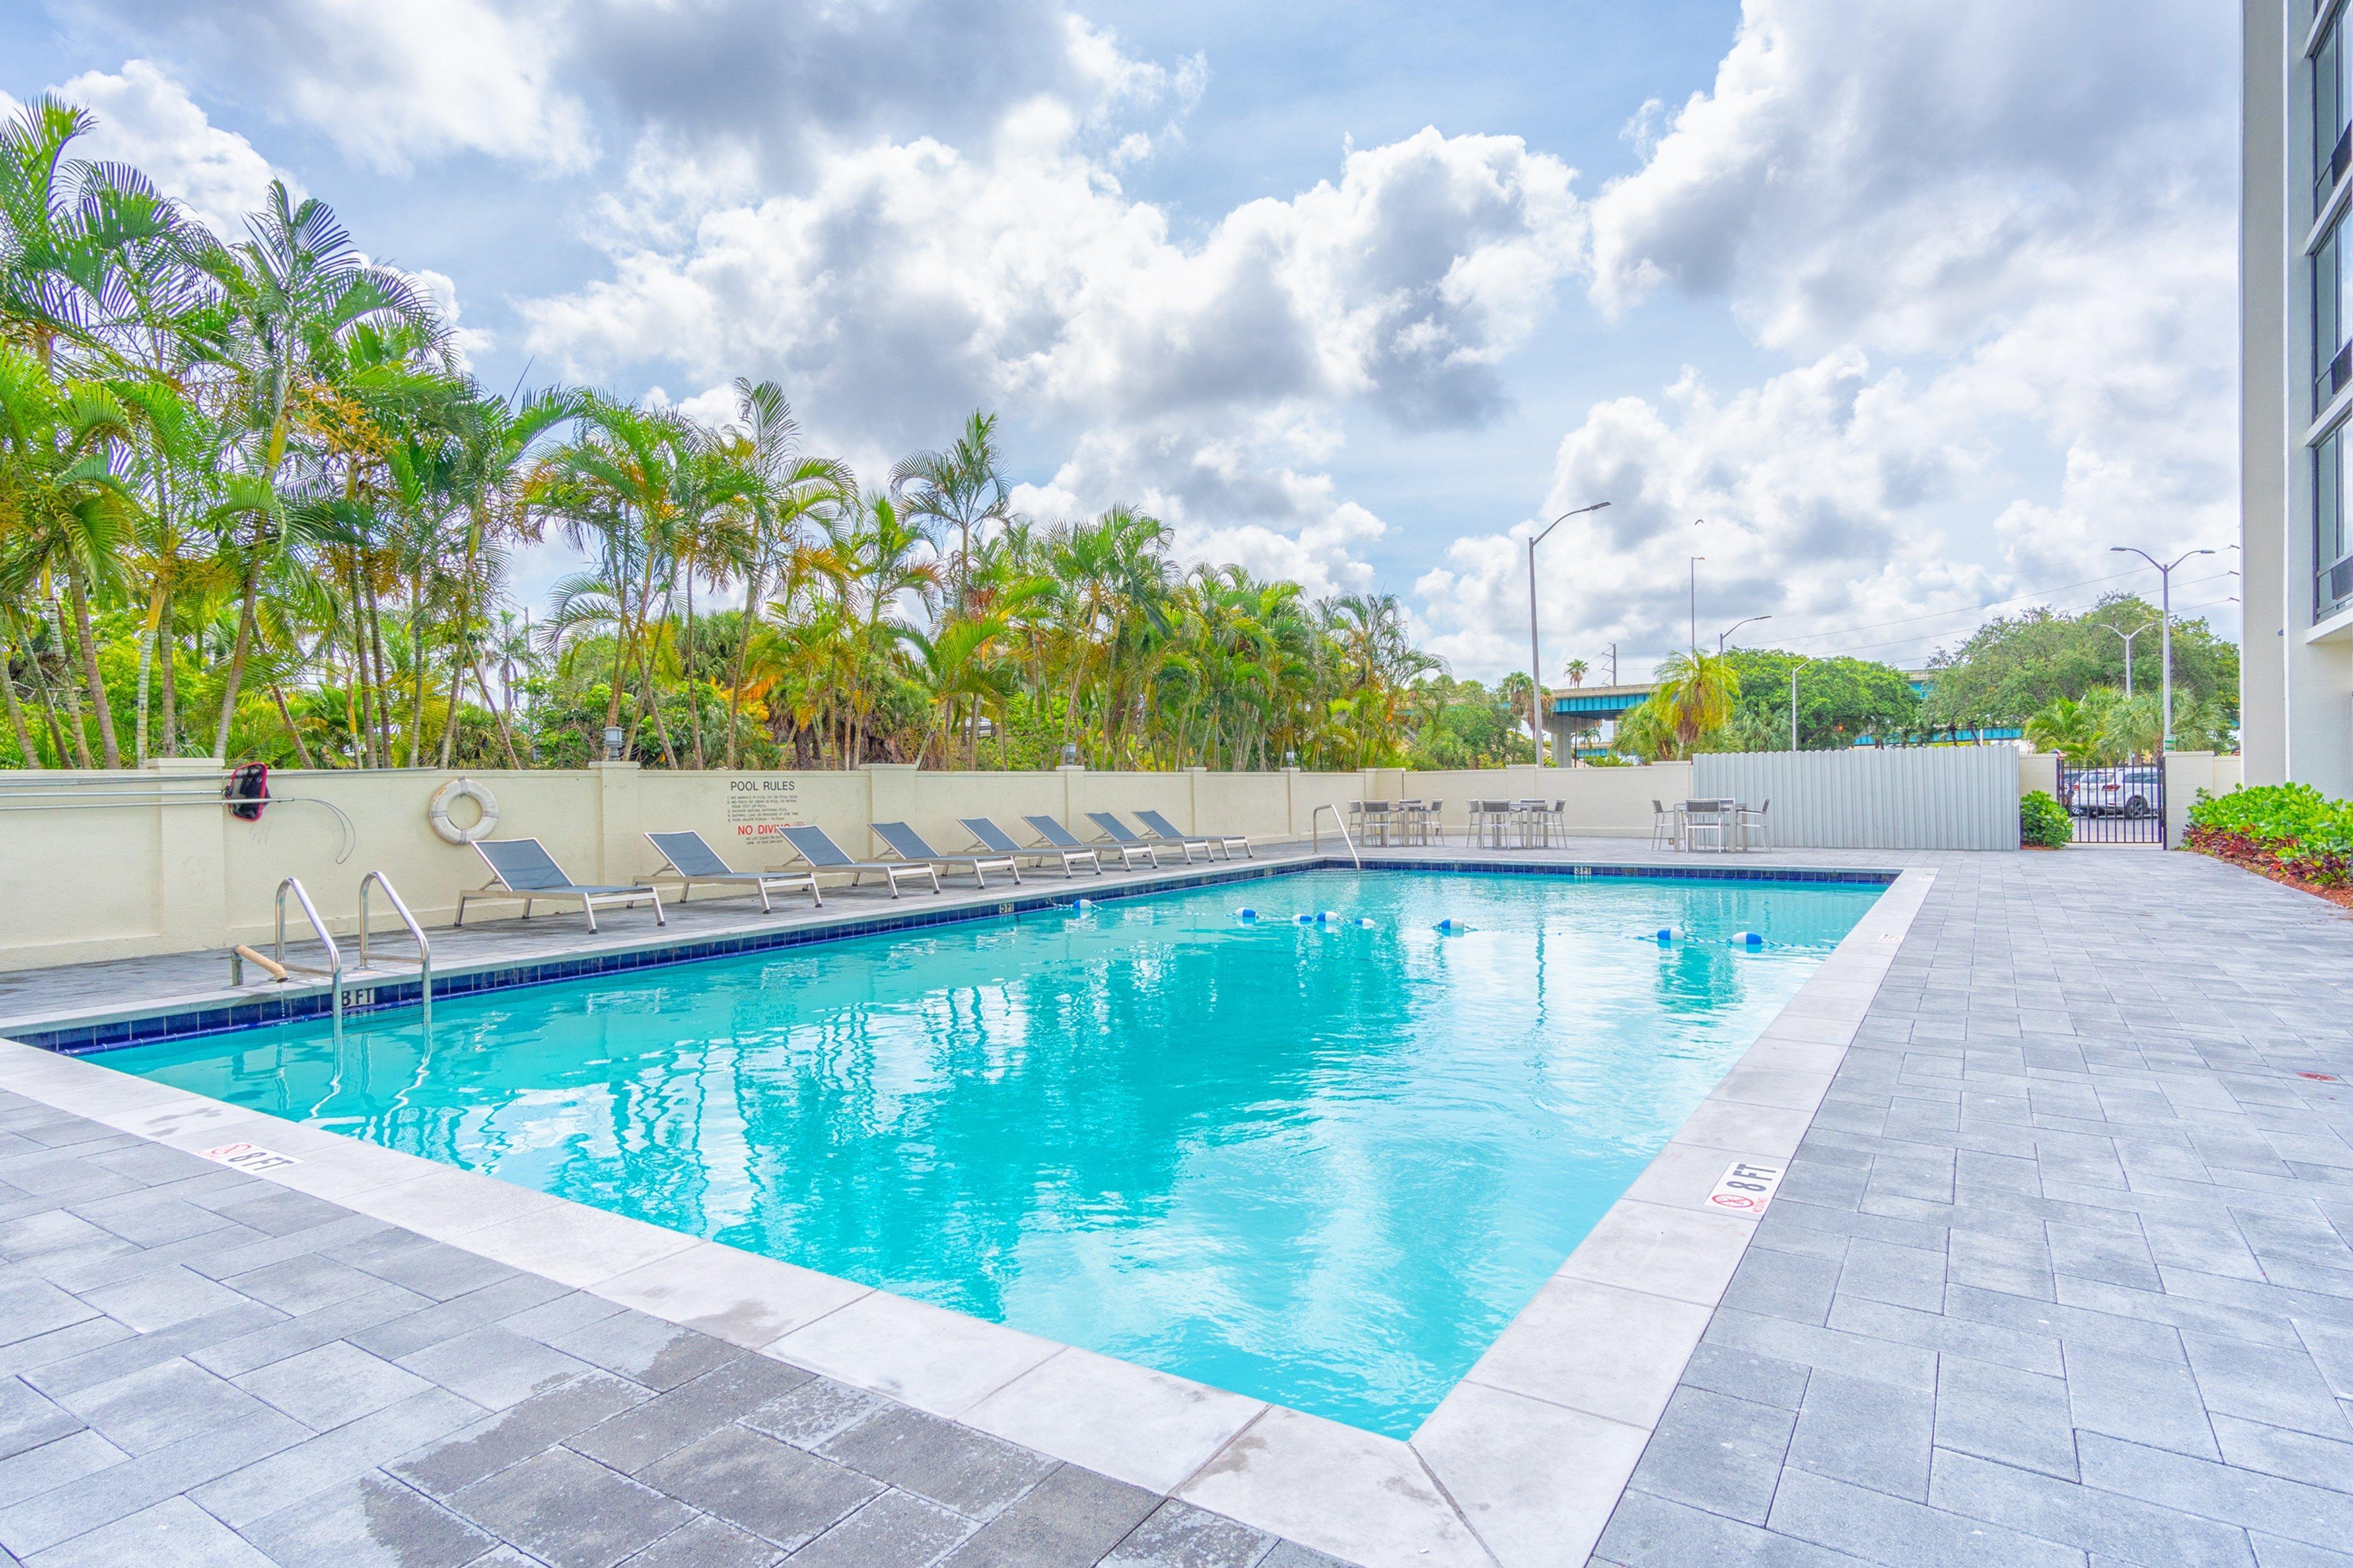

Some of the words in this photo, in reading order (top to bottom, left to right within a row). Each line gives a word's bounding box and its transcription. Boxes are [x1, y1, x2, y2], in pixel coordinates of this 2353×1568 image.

[731, 781, 759, 791] POOL
[763, 781, 795, 791] RULES
[738, 825, 753, 835] NO
[758, 824, 790, 834] DIVI
[1576, 866, 1581, 874] 3
[1001, 904, 1006, 912] 5
[342, 990, 351, 1007] 8
[356, 988, 373, 1004] FT
[227, 1152, 267, 1162] 8
[241, 1157, 295, 1171] FT
[1732, 1163, 1777, 1181] FT
[1726, 1181, 1767, 1192] 8
